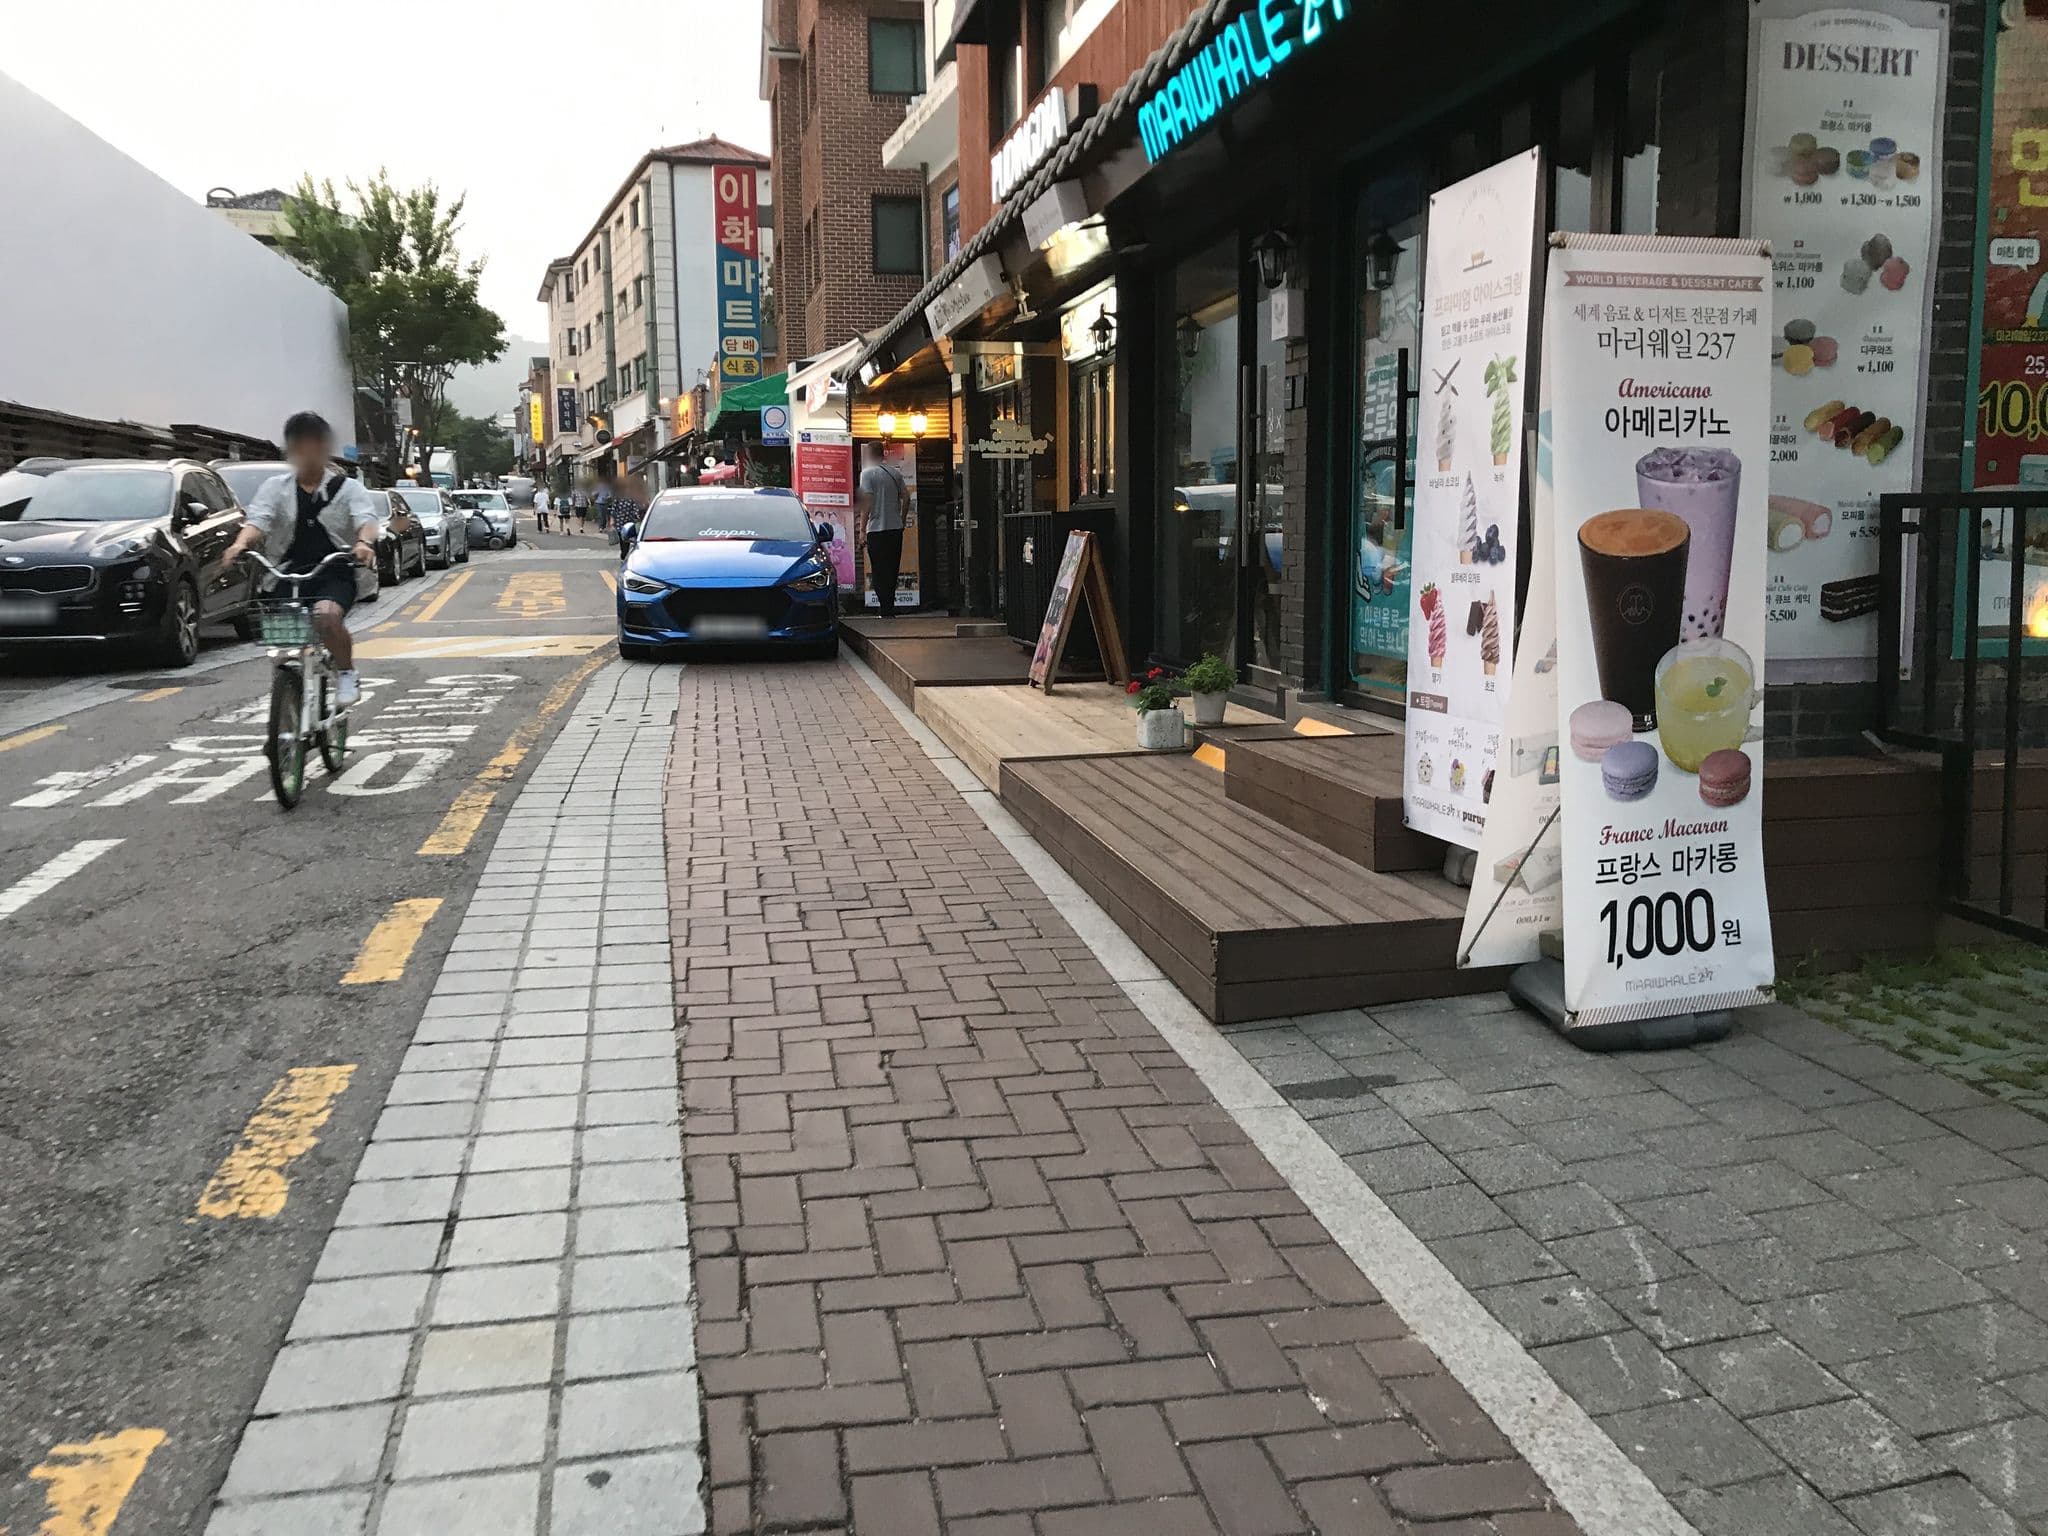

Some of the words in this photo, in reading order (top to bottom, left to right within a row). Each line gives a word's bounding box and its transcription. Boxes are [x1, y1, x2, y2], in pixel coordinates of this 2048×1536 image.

[1783, 42, 1920, 77] DESSERT
[1138, 0, 1291, 165] MARIWHALE
[719, 173, 756, 328] 이화마트
[1576, 273, 1613, 285] WORLD
[1616, 275, 1671, 287] BEVERAGE
[1672, 277, 1680, 287] &
[1681, 278, 1725, 289] DESSERT
[1727, 278, 1753, 290] CAFE
[1786, 276, 1815, 290] 1,100
[1573, 303, 1600, 321] 세계
[1603, 303, 1631, 322] 음료
[1634, 307, 1645, 322] &
[1649, 304, 1688, 324] 디저트
[1691, 306, 1730, 325] 전문점
[1733, 306, 1758, 326] 카페
[725, 338, 755, 353] 담배
[726, 359, 756, 374] 식품
[1867, 360, 1894, 375] 1,100
[1618, 377, 1713, 399] Americano
[1604, 405, 1731, 439] 아메리카노
[1769, 450, 1798, 462] 2,000
[1769, 609, 1797, 621] 5,500
[1599, 825, 1655, 846] France
[1658, 818, 1729, 840] Macaron
[1595, 852, 1662, 885] 프랑스
[1672, 842, 1739, 877] 마카롱
[1600, 888, 1716, 970] 1,000
[1720, 918, 1742, 946] 원
[1625, 973, 1697, 992] MARIWHALE
